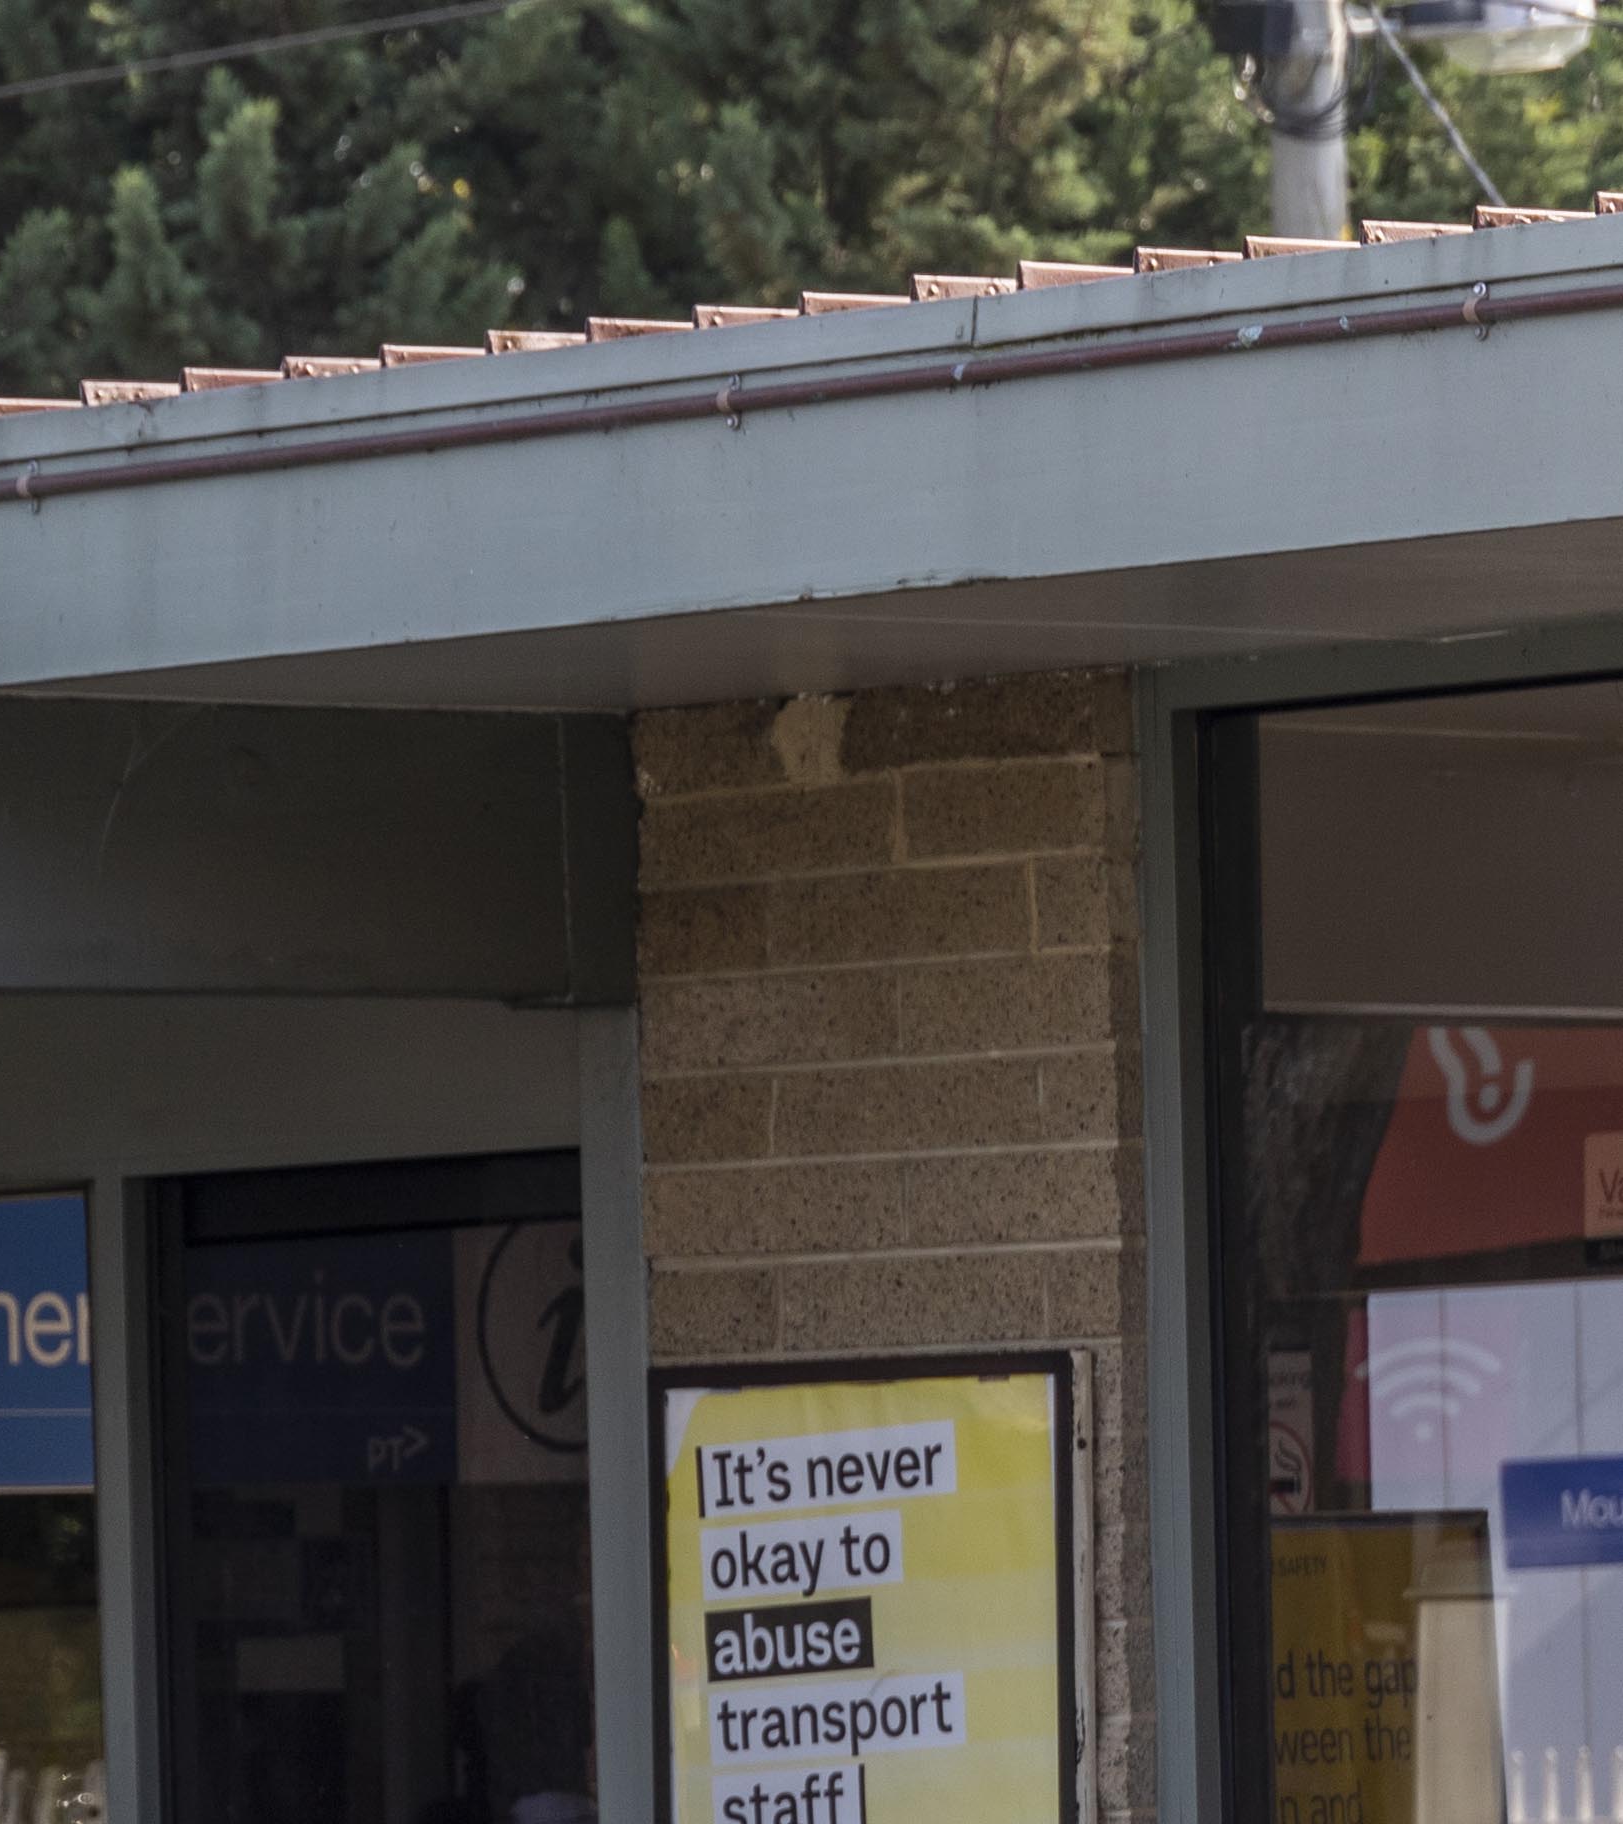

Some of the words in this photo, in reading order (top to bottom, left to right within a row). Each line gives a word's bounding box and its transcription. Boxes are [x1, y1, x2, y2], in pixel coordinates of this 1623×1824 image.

[186, 1270, 425, 1368] ervice
[712, 1446, 791, 1508] It's
[806, 1443, 943, 1499] never
[710, 1530, 825, 1597] okay
[839, 1524, 891, 1577] to
[714, 1612, 861, 1676] abuse
[1307, 1650, 1355, 1698] the
[716, 1680, 953, 1757] transport
[1365, 1715, 1412, 1763] the
